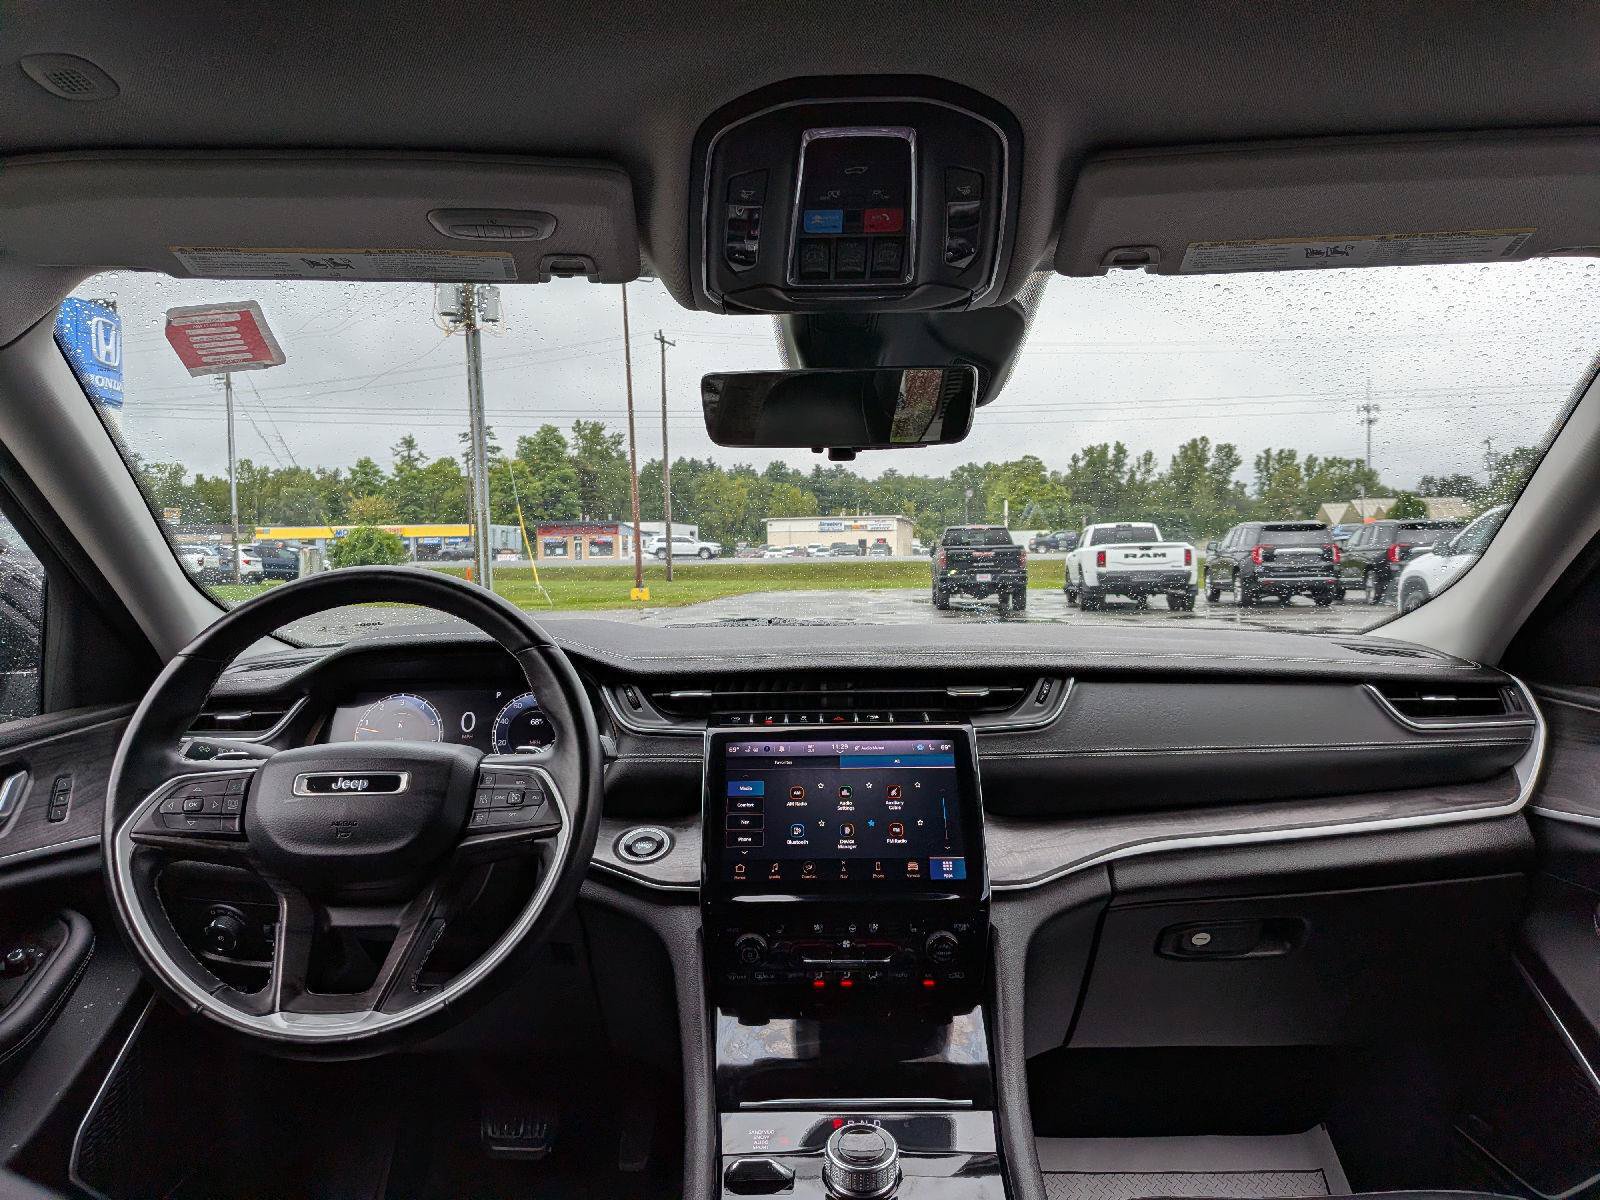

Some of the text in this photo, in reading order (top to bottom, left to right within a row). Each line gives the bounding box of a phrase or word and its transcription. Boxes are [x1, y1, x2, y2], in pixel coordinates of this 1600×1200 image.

[496, 691, 502, 699] P
[461, 711, 476, 733] 0
[497, 739, 507, 747] 20
[331, 776, 369, 791] Jeep
